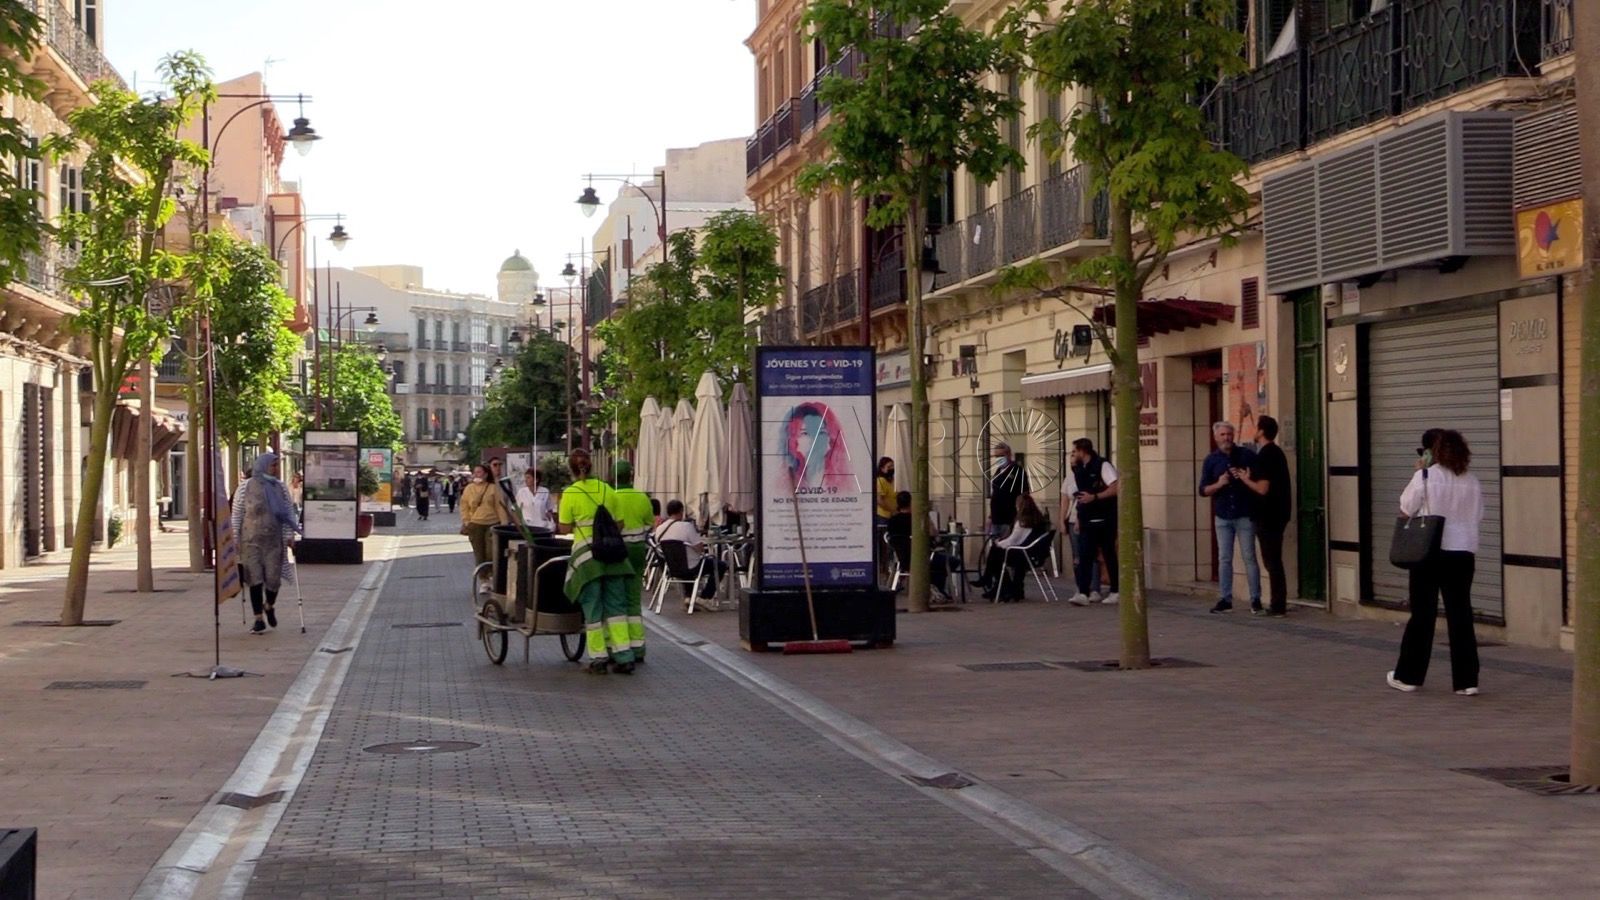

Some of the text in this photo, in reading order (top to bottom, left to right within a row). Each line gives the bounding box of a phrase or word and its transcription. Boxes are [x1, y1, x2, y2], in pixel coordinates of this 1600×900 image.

[765, 358, 863, 368] JÓVENES Y COVID-19
